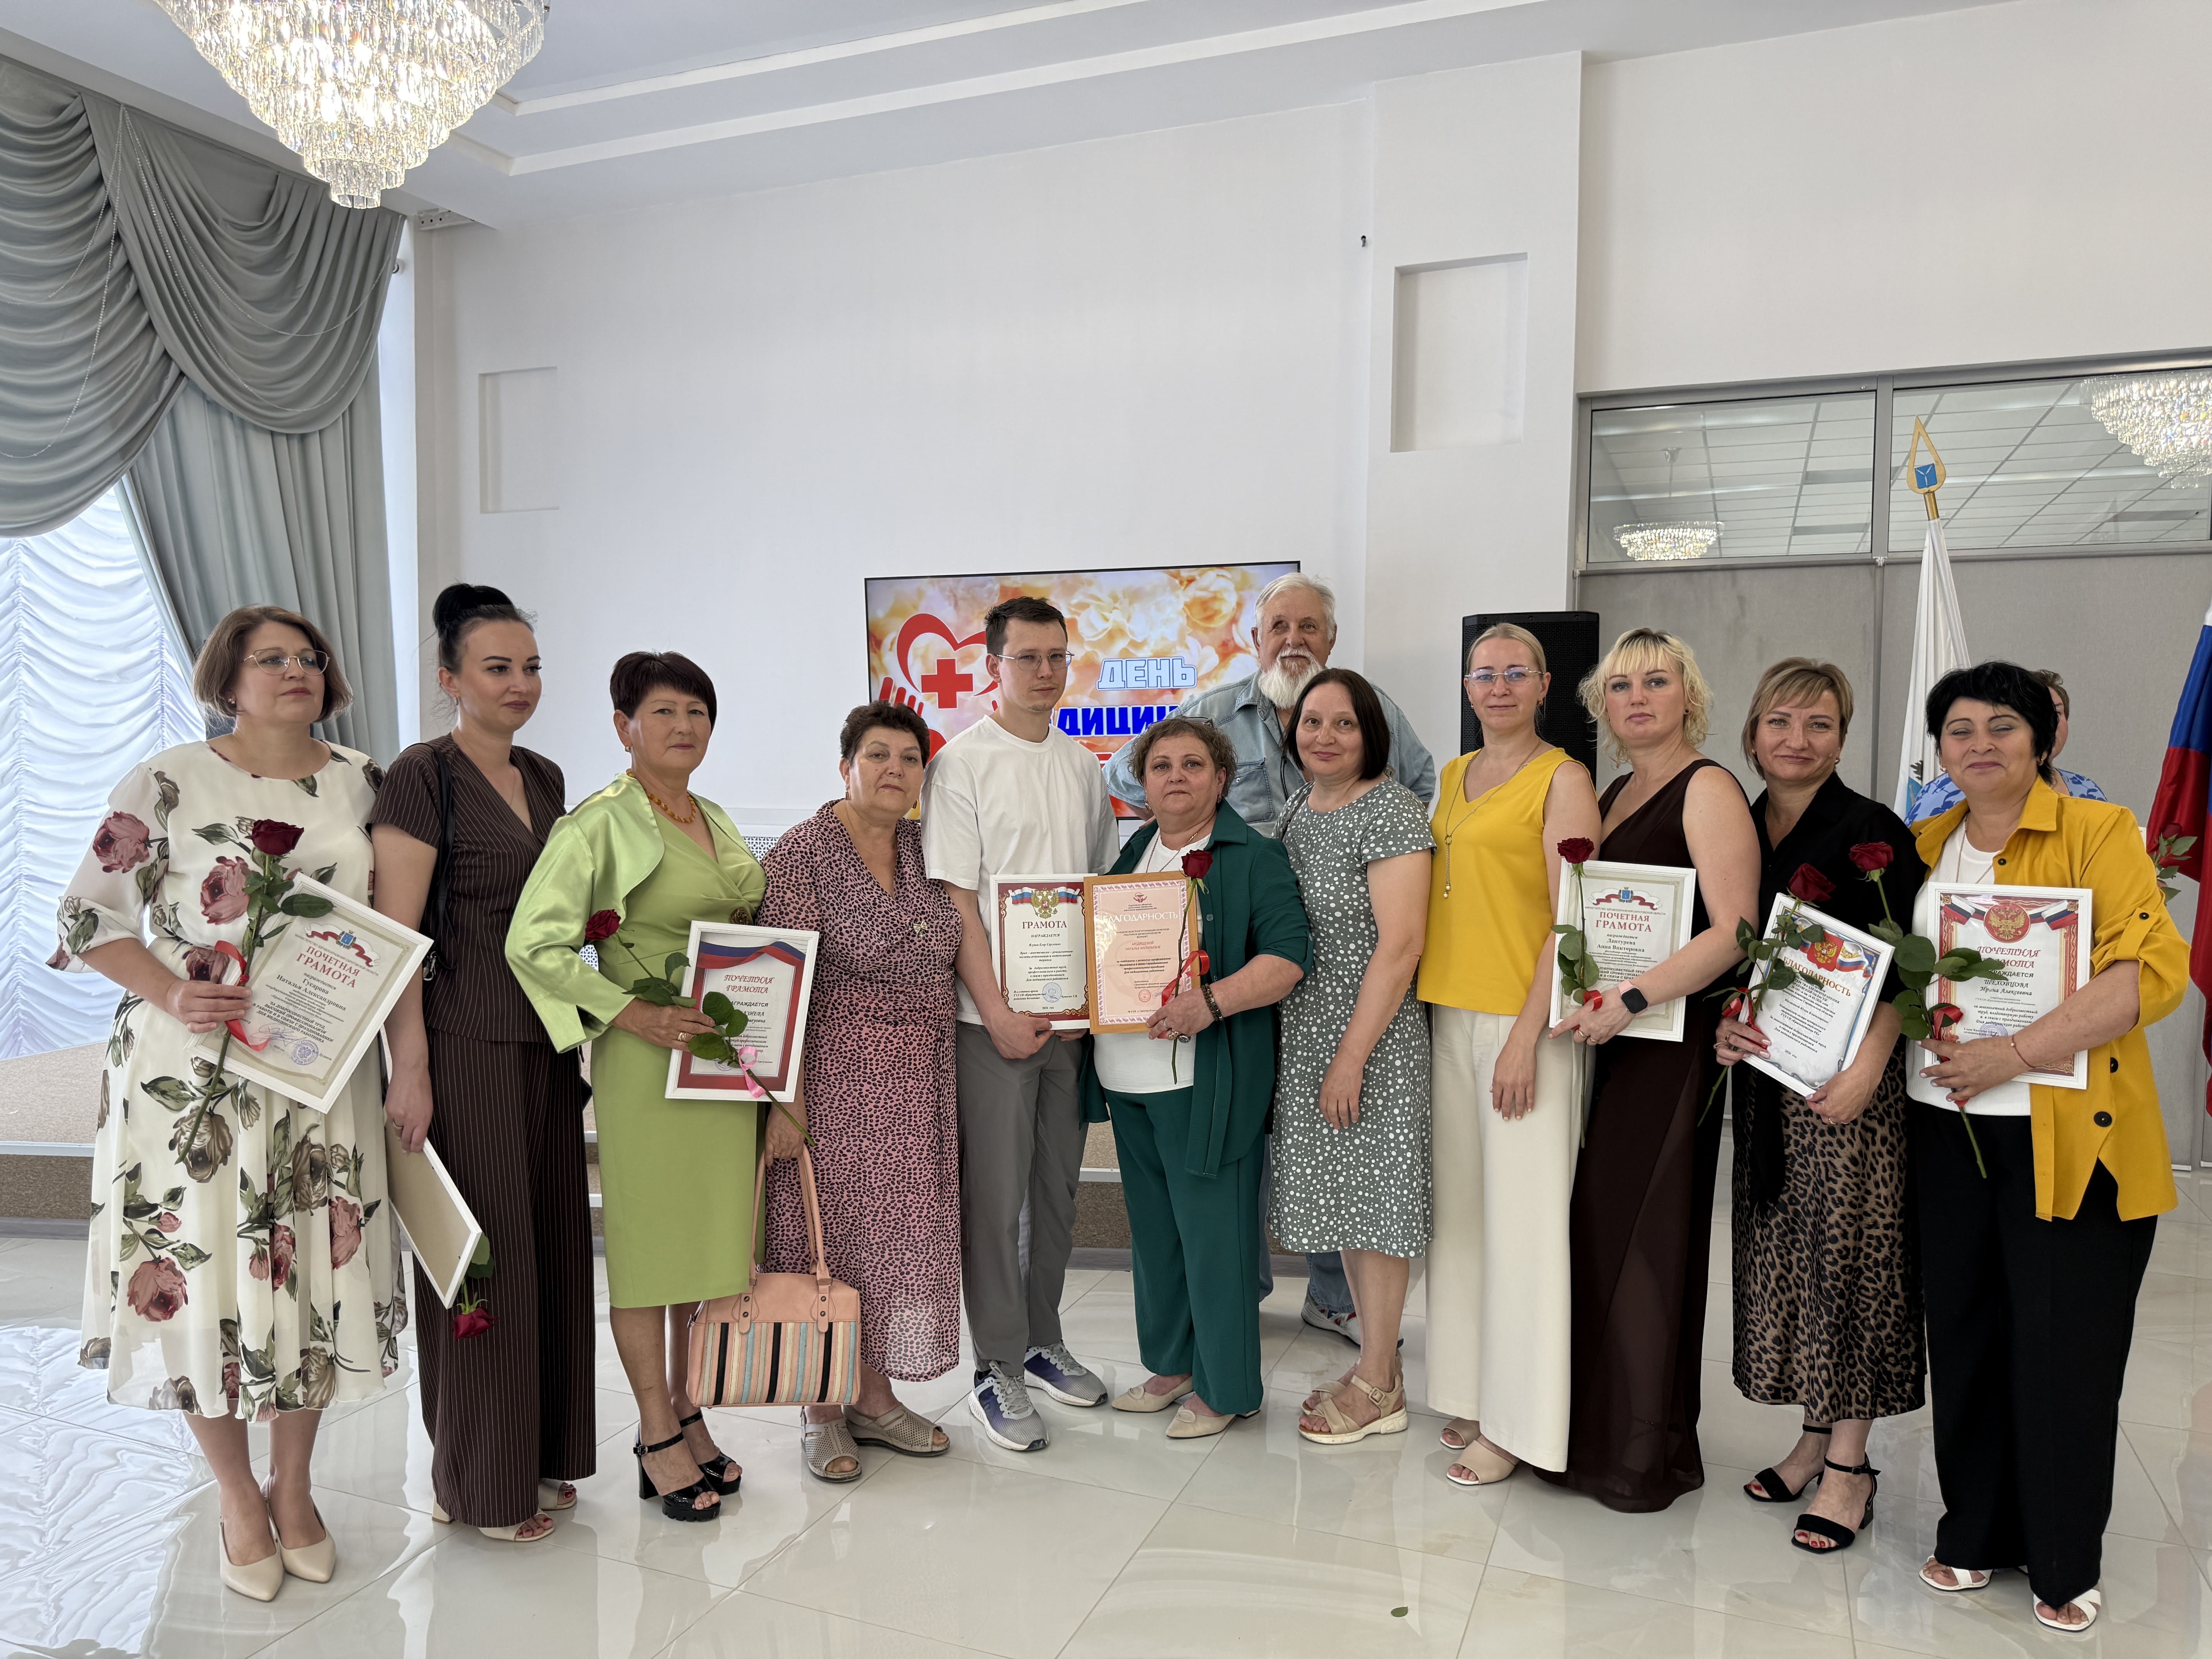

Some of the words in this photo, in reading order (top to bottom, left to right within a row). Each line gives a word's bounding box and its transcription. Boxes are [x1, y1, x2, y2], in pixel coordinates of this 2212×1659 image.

[1097, 658, 1196, 690] ДЕНЬ
[1050, 705, 1179, 735] ДИЦИ
[1103, 912, 1178, 923] БЛАГОДАРНОСТЬ
[1600, 912, 1649, 922] ПОЧЕТНАЯ
[1022, 921, 1066, 929] ГРАМОТА
[1595, 919, 1652, 932] ГРАМОТА
[1612, 945, 1644, 953] Викторовна
[1977, 946, 2040, 958] ПОЧЕТНАЯ
[306, 946, 361, 976] ПОЧЕТНАЯ
[296, 953, 358, 988] ГРАМОТА
[1782, 957, 1852, 997] БЛАГОДАРНОСТЬ
[303, 972, 337, 991] награждается
[724, 974, 775, 984] ПОЧЕТНАЯ
[1984, 979, 2028, 988] ШЕХОВЦОВА
[276, 974, 302, 990] Наталья
[302, 987, 347, 1011] Александровна
[302, 978, 330, 995] Гусарова
[726, 984, 769, 994] ГРАМОТА
[264, 1003, 285, 1015] ВЫСОКИЙ
[275, 1004, 314, 1024] ДОБРОСОВЕСТНЫЙ
